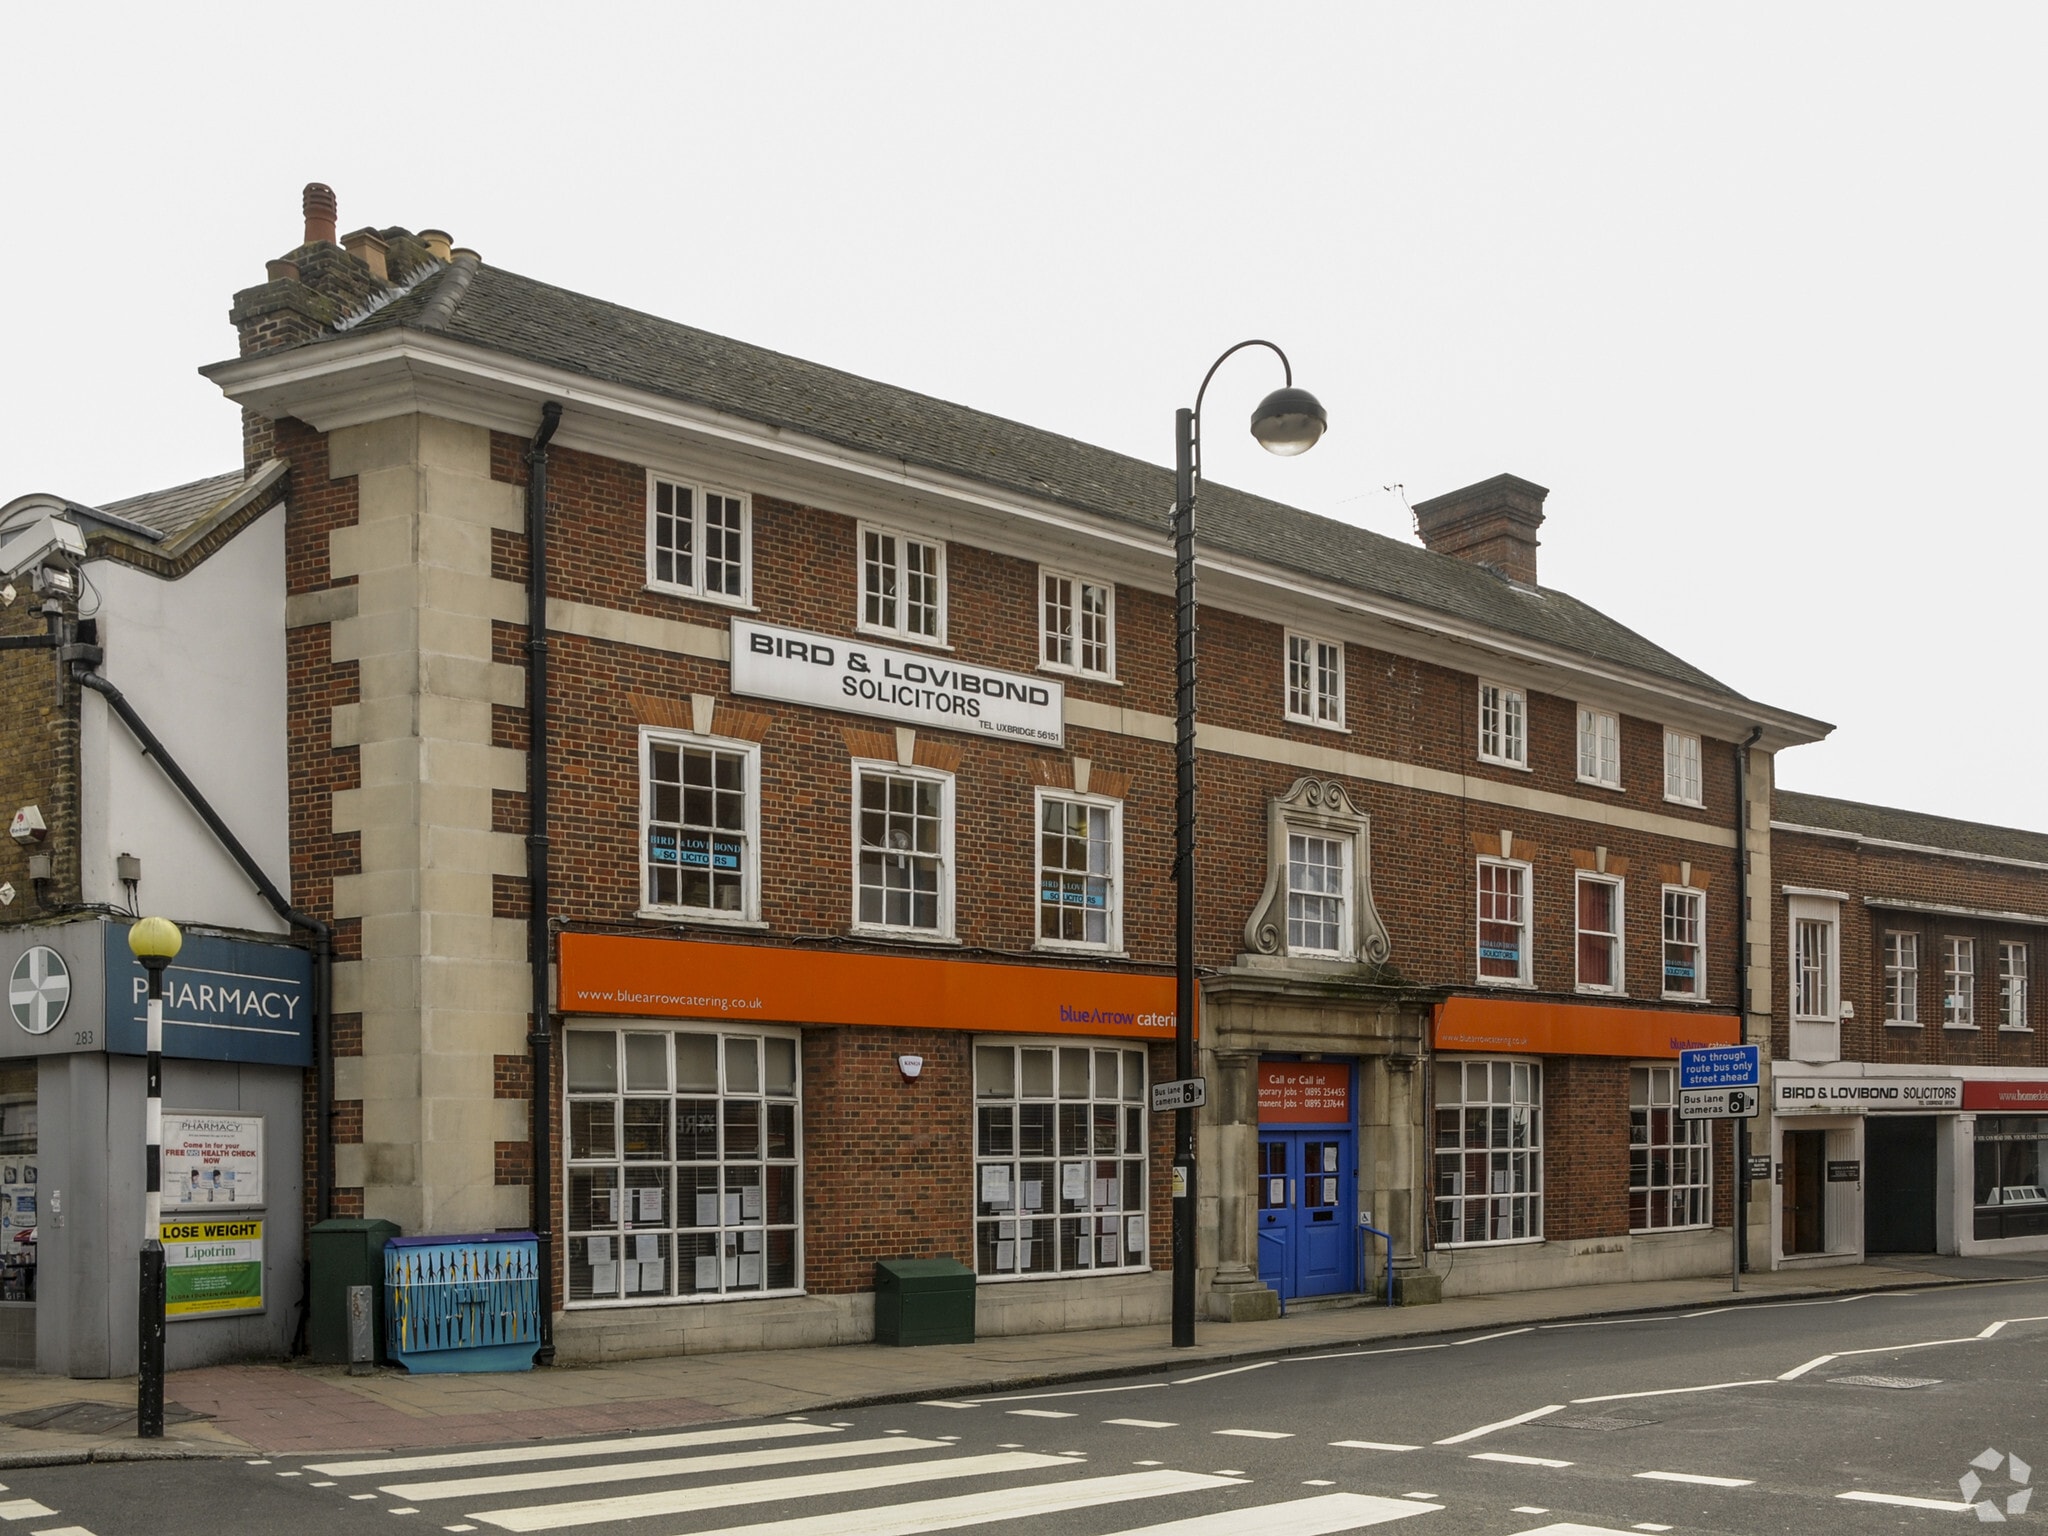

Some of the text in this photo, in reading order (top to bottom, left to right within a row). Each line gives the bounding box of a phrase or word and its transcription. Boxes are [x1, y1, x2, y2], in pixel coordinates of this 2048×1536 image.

[750, 632, 1049, 706] BIRD & LOVIBOND
[842, 675, 980, 718] SOLICITORS
[979, 719, 1060, 742] TEL UXBRIDGE 56151
[650, 835, 674, 846] BIRD
[686, 839, 741, 853] LOVIBOND
[664, 850, 727, 866] SOLICITORS
[1050, 892, 1096, 904] SOLICITORS
[1483, 950, 1513, 959] SOLICITORS
[133, 977, 300, 1020] PHARMACY
[577, 990, 763, 1010] www.bluearrowcatering.co.uk
[1137, 1012, 1176, 1027] cateri
[75, 1031, 94, 1045] 283
[1692, 1051, 1746, 1062] No through
[1686, 1061, 1752, 1074] route bus only
[1270, 1074, 1284, 1084] Call
[1299, 1076, 1314, 1084] Call
[1316, 1076, 1326, 1085] in!
[1690, 1072, 1748, 1084] street ahead
[1154, 1088, 1166, 1096] Bus
[1258, 1088, 1282, 1098] porary
[1284, 1088, 1297, 1097] Jobs
[1304, 1088, 1321, 1096] 01895
[1324, 1088, 1346, 1096] 254455
[1782, 1086, 1956, 1100] BIRD & LOVIBOND SOLICITORS
[1156, 1097, 1180, 1106] cameras
[1284, 1099, 1297, 1109] Jobs
[1304, 1099, 1321, 1108] 01895
[1324, 1099, 1344, 1108] 237644
[1684, 1096, 1701, 1104] Bus
[1684, 1106, 1723, 1114] cameras
[182, 1122, 240, 1131] PHARMACY
[163, 1224, 256, 1238] LOSE WEIGHT
[185, 1245, 236, 1260] Lipotrim
